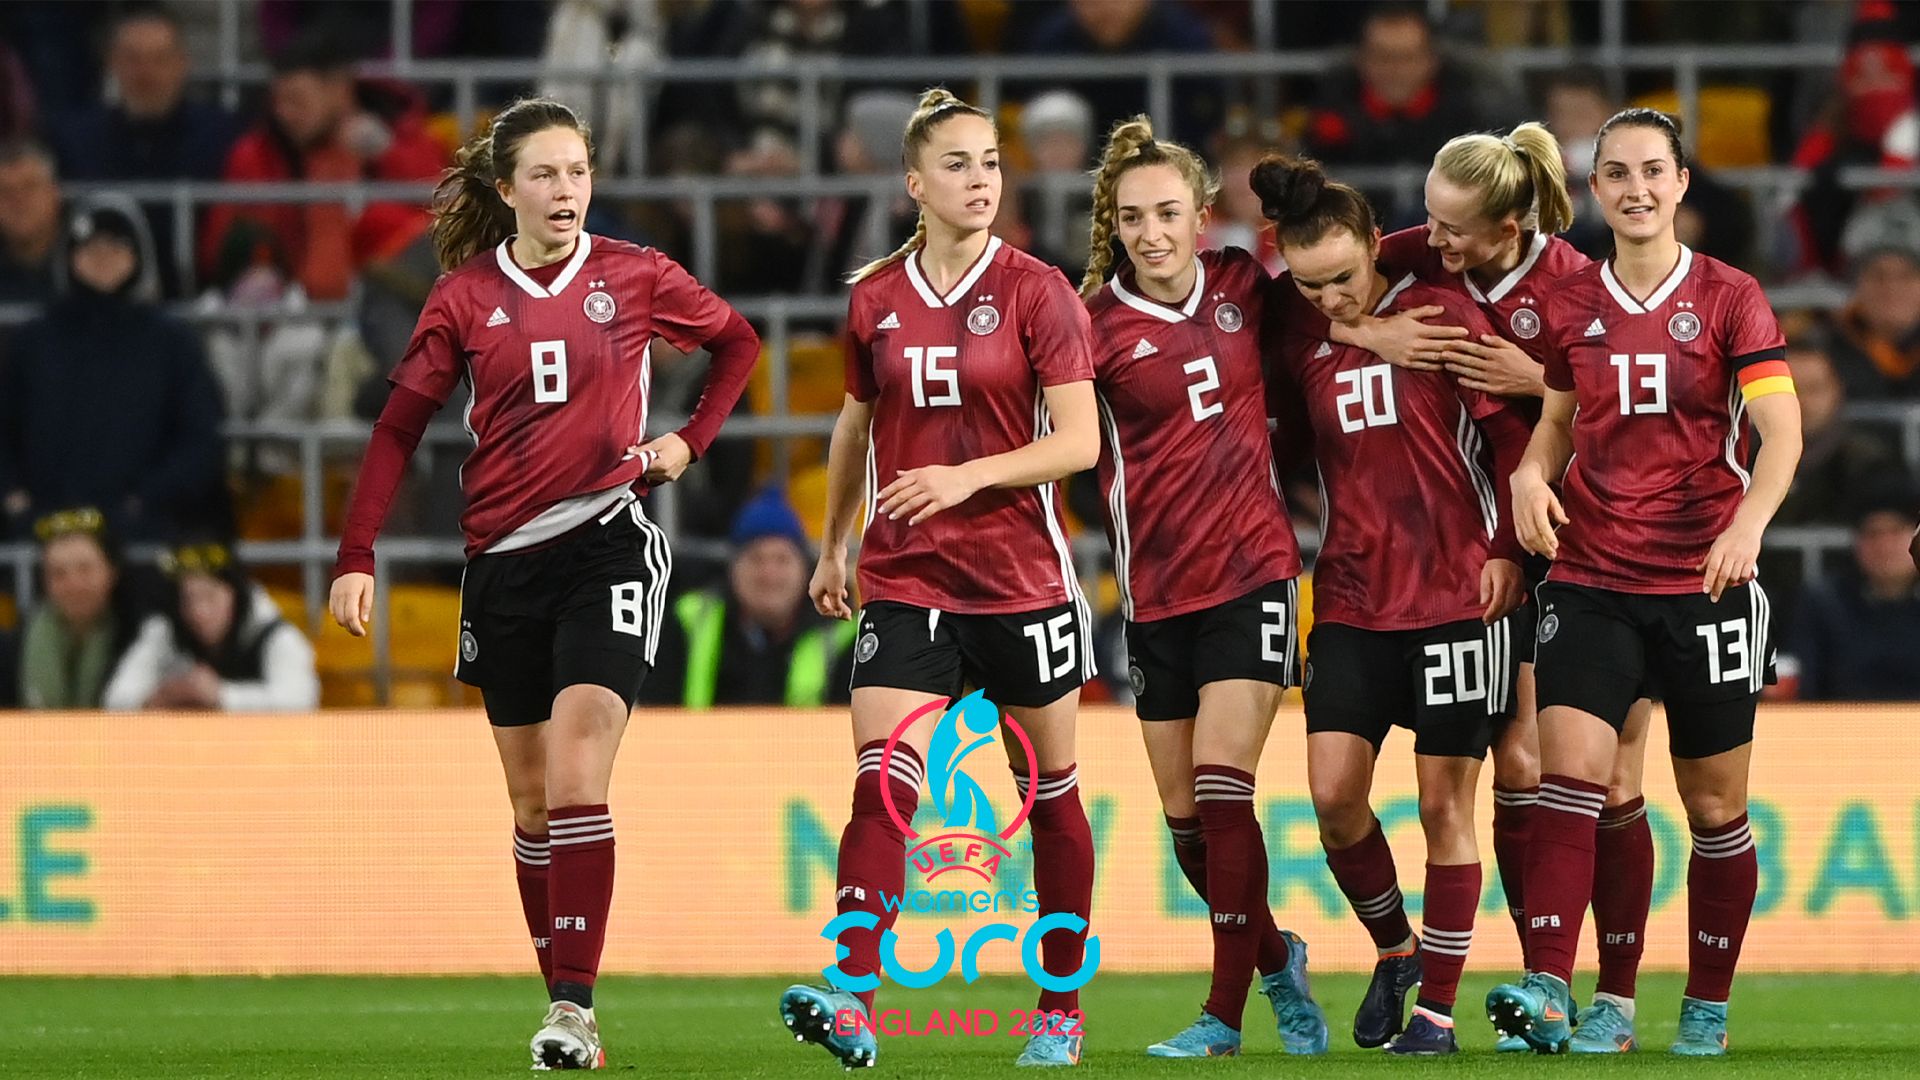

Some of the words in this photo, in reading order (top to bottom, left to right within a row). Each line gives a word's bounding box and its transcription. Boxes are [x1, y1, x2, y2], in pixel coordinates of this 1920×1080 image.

[530, 340, 568, 403] 8
[903, 346, 962, 408] 15
[1183, 355, 1224, 422] 2
[1335, 363, 1399, 434] 20
[1609, 353, 1668, 416] 13
[610, 581, 644, 637] 8
[1261, 601, 1286, 663] 2
[1023, 612, 1076, 684] 15
[1424, 639, 1487, 706] 20
[1696, 617, 1750, 684] 13
[0, 803, 95, 922] E
[533, 937, 552, 949] DF
[555, 916, 586, 931] DFB
[1214, 912, 1246, 926] DFB
[1531, 914, 1561, 928] DFB
[1606, 931, 1636, 945] DFB
[1698, 930, 1729, 949] DFB
